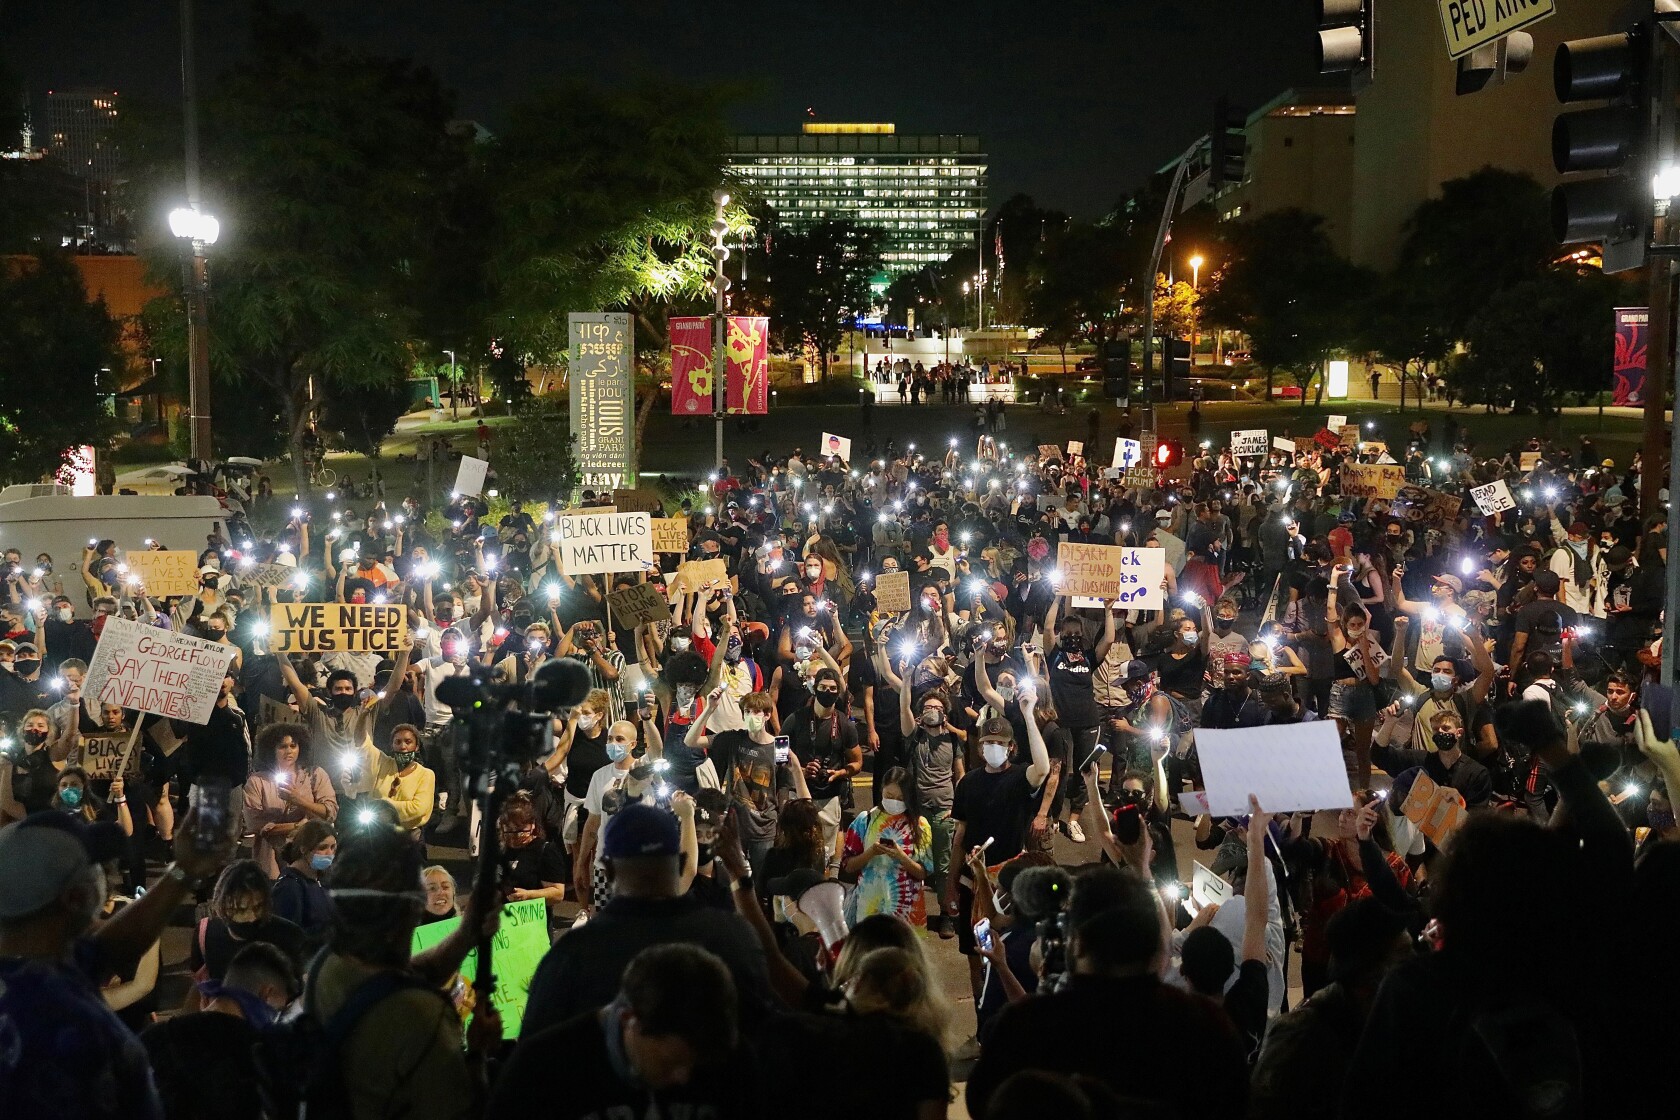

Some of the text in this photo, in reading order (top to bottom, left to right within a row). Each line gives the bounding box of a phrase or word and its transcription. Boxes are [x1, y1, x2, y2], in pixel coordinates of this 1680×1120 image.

[1449, 0, 1486, 41] PED
[598, 444, 625, 452] PARK
[1233, 444, 1268, 454] SCURLOCK
[1241, 436, 1267, 445] JAMES
[1129, 467, 1153, 478] FUCK
[1126, 476, 1154, 487] TRUMP
[1483, 496, 1495, 504] THE
[562, 517, 645, 539] BLACK LIVES
[658, 531, 688, 541] LIVES
[129, 555, 188, 566] BLACK
[1060, 544, 1107, 561] DISARM
[142, 567, 184, 580] LIVES
[256, 565, 278, 586] LIVES
[1063, 561, 1113, 578] DEFUND
[610, 586, 646, 606] STOP
[619, 595, 657, 617] KILLING
[285, 605, 401, 628] WE NEED
[635, 610, 653, 623] US
[112, 620, 131, 632] TONY
[200, 639, 225, 653] TAYLOR
[278, 628, 399, 651] JUSTICE
[138, 636, 225, 670] GEORGE FLOYD
[108, 649, 148, 680] SAY
[151, 659, 190, 690] THEIR
[97, 677, 198, 720] NAMES
[95, 758, 134, 771] LIVES
